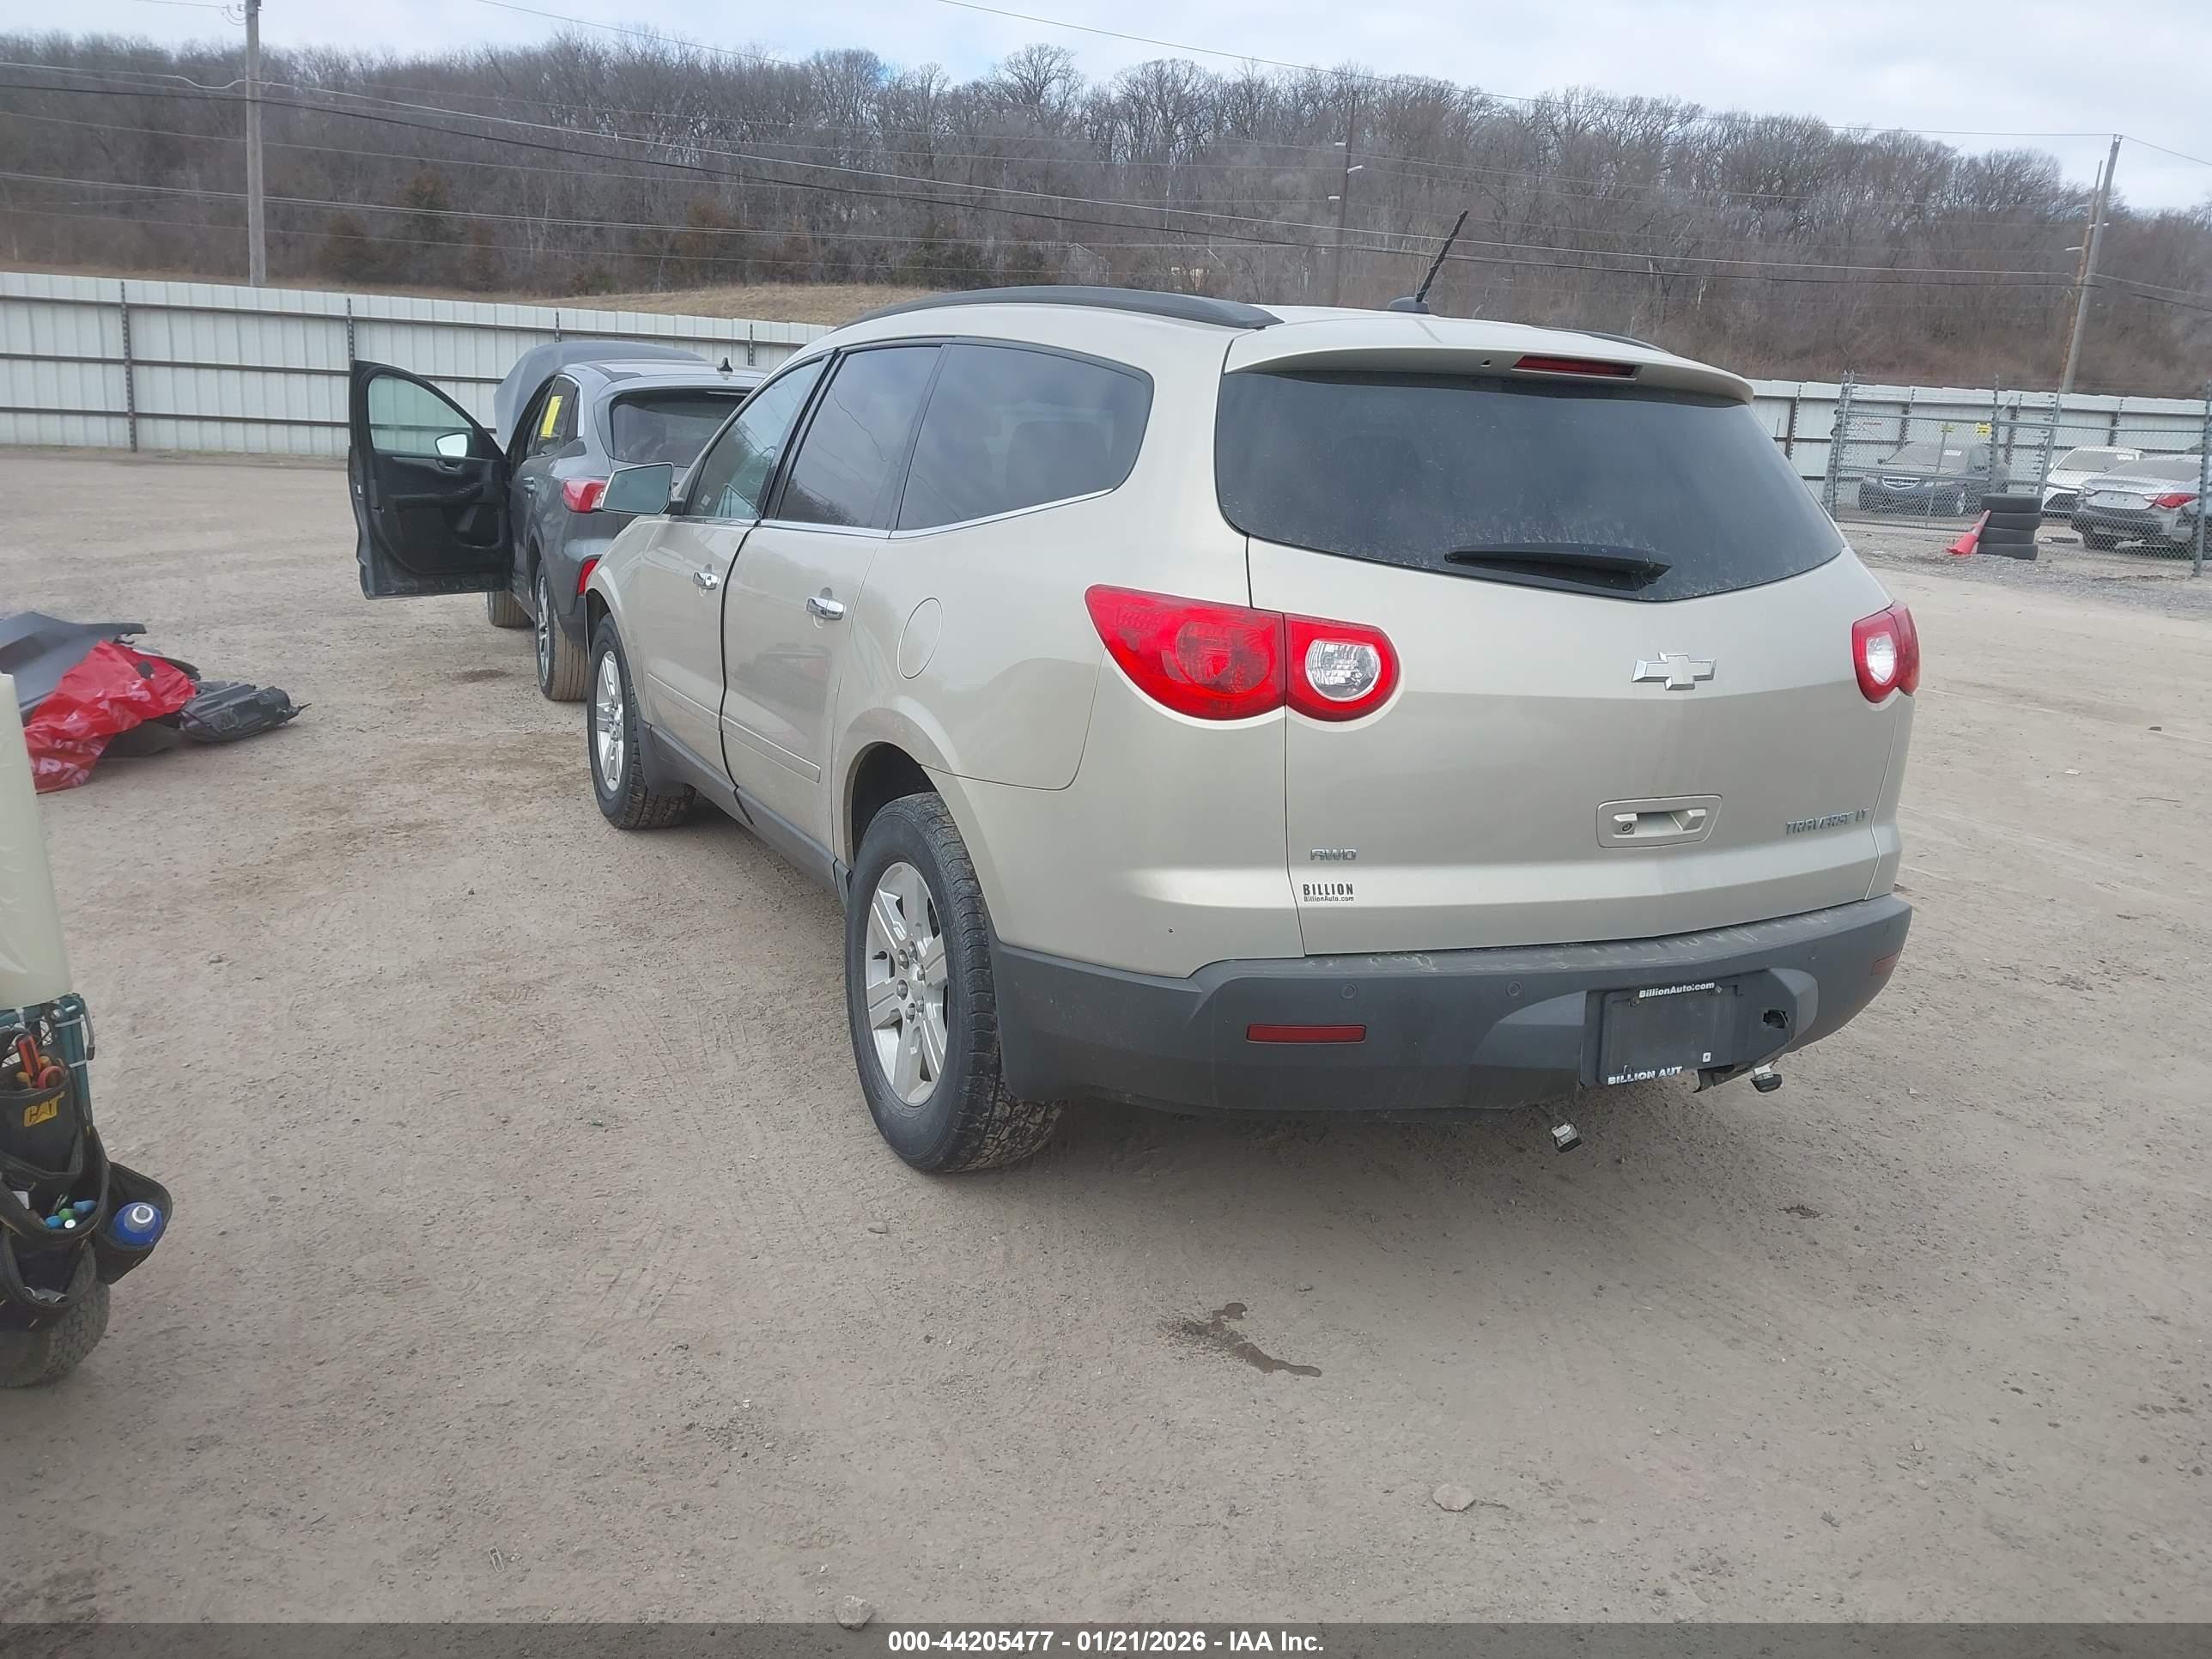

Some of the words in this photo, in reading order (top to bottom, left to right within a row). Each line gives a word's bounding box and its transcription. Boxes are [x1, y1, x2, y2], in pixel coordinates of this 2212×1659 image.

[1310, 848, 1357, 860] AWD
[1303, 883, 1354, 895] BILLION
[1638, 981, 1715, 998] BillionAuto.com
[1607, 1070, 1655, 1085] BILLION
[24, 1091, 65, 1127] CAT
